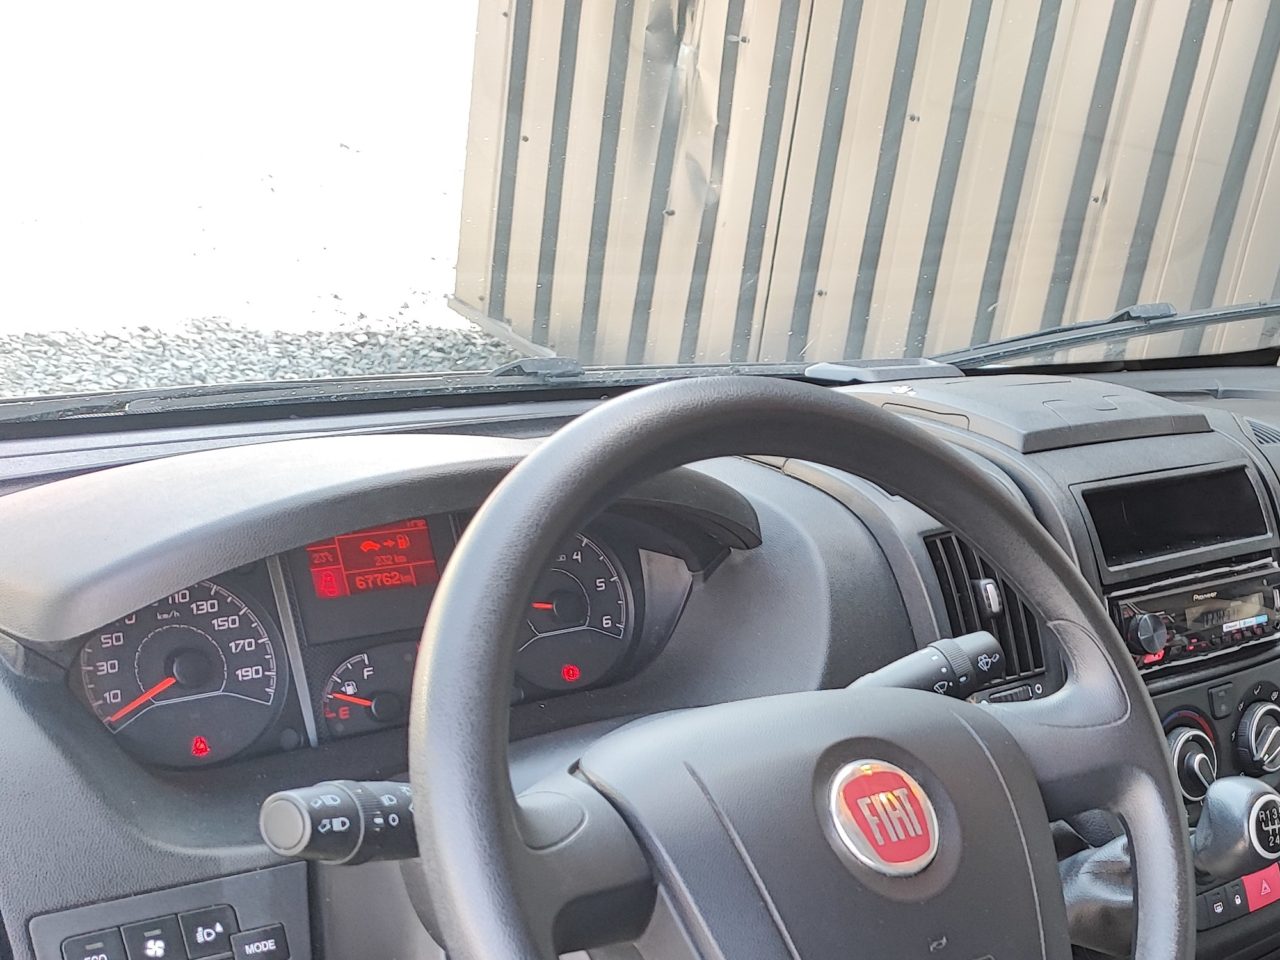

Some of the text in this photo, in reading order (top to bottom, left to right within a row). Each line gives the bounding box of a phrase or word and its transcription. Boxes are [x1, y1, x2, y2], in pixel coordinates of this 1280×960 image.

[572, 551, 581, 563] 4
[355, 571, 400, 589] 67762
[596, 579, 605, 590] 5
[190, 600, 218, 614] 130
[212, 615, 239, 630] 150
[602, 616, 612, 627] 6
[101, 633, 124, 647] 50
[229, 638, 255, 653] 170
[96, 660, 118, 675] 30
[236, 666, 262, 681] 190
[364, 667, 374, 679] F
[104, 690, 121, 703] 10
[339, 706, 350, 719] E
[857, 788, 923, 845] FIAT
[245, 939, 276, 955] MODE
